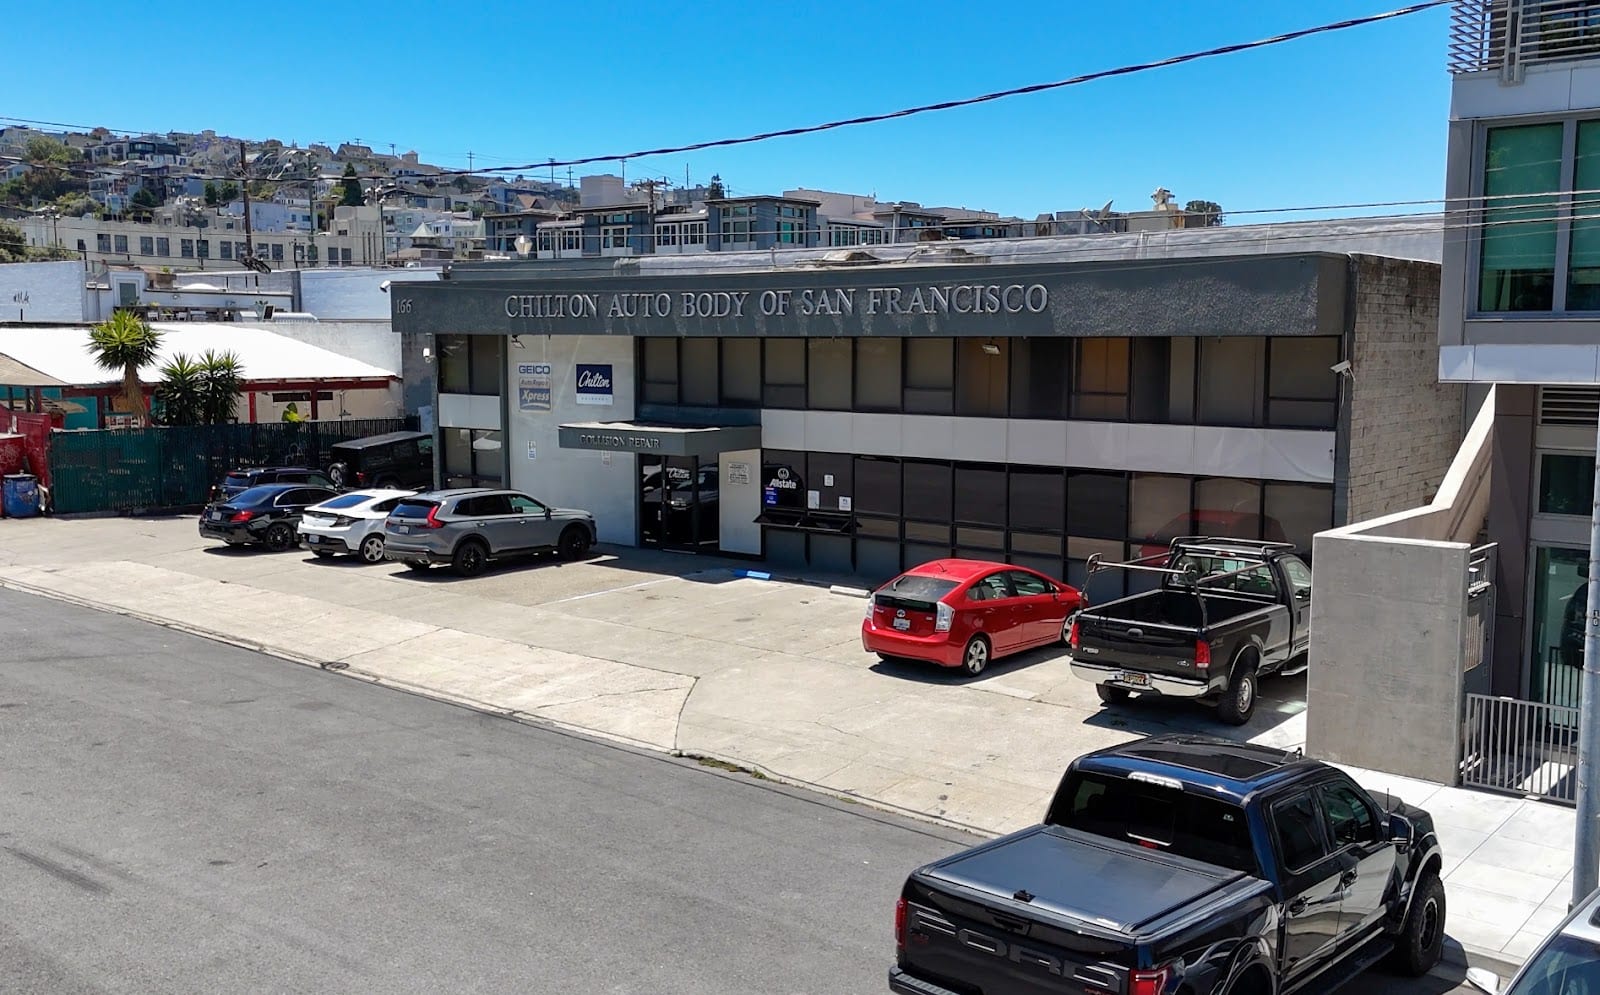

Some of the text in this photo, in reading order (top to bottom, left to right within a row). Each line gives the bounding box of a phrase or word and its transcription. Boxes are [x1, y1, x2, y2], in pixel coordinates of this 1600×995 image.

[395, 298, 412, 315] 166
[504, 284, 1048, 319] CHILTON AUTO BODY OF SAN FRANCISCO
[518, 365, 551, 375] GEICO
[578, 370, 610, 388] Chilton
[522, 389, 550, 403] Xpress
[580, 434, 660, 449] COLLISION REPAIR
[769, 478, 797, 489] Allstate
[909, 909, 1121, 993] FORD
